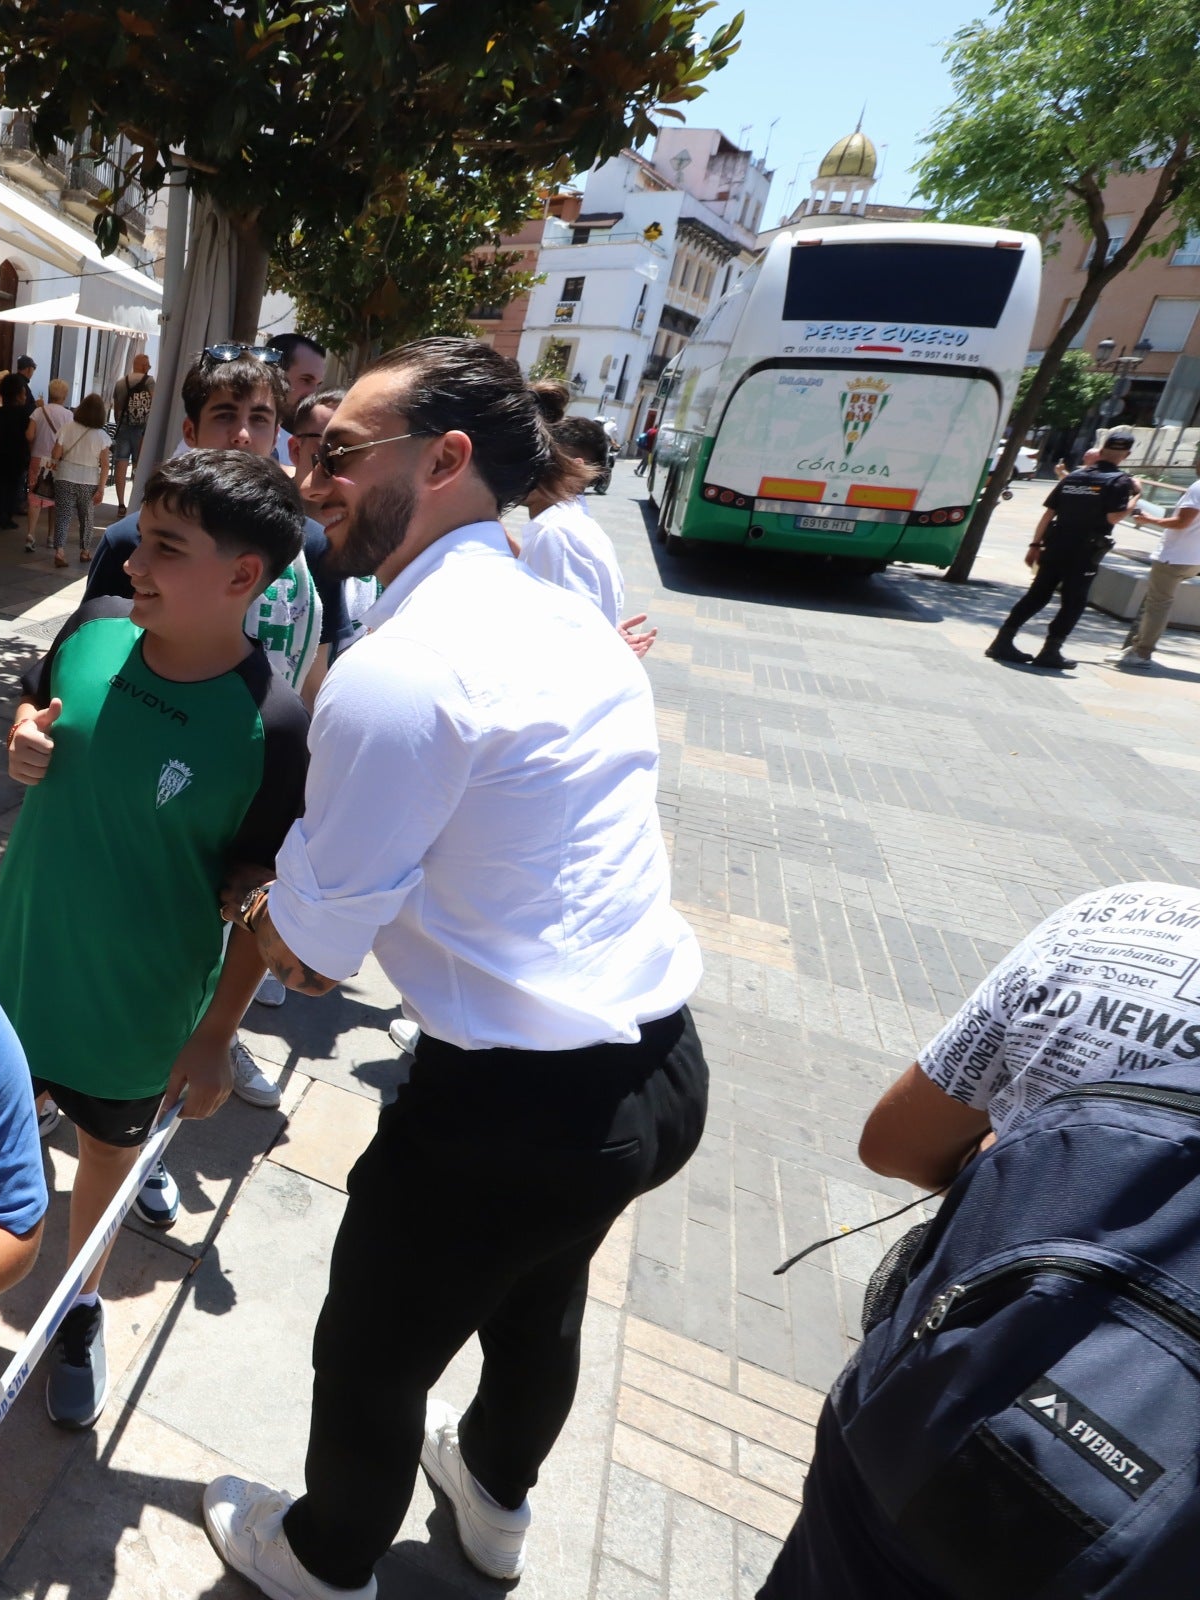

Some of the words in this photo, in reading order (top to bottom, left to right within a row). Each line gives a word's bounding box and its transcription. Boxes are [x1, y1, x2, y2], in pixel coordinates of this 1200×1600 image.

[804, 322, 876, 342] PEREZ
[878, 324, 970, 347] CUBERO
[798, 345, 814, 354] 957
[828, 346, 840, 354] 40
[924, 350, 941, 359] 957
[943, 351, 954, 360] 41
[797, 457, 891, 478] CÓRDOBA
[802, 517, 830, 529] 6916
[831, 520, 852, 532] HTL
[109, 674, 189, 727] GIVOVA
[1022, 984, 1083, 1019] RLD
[1086, 995, 1200, 1060] NEWS
[1067, 1419, 1145, 1480] EVEREST
